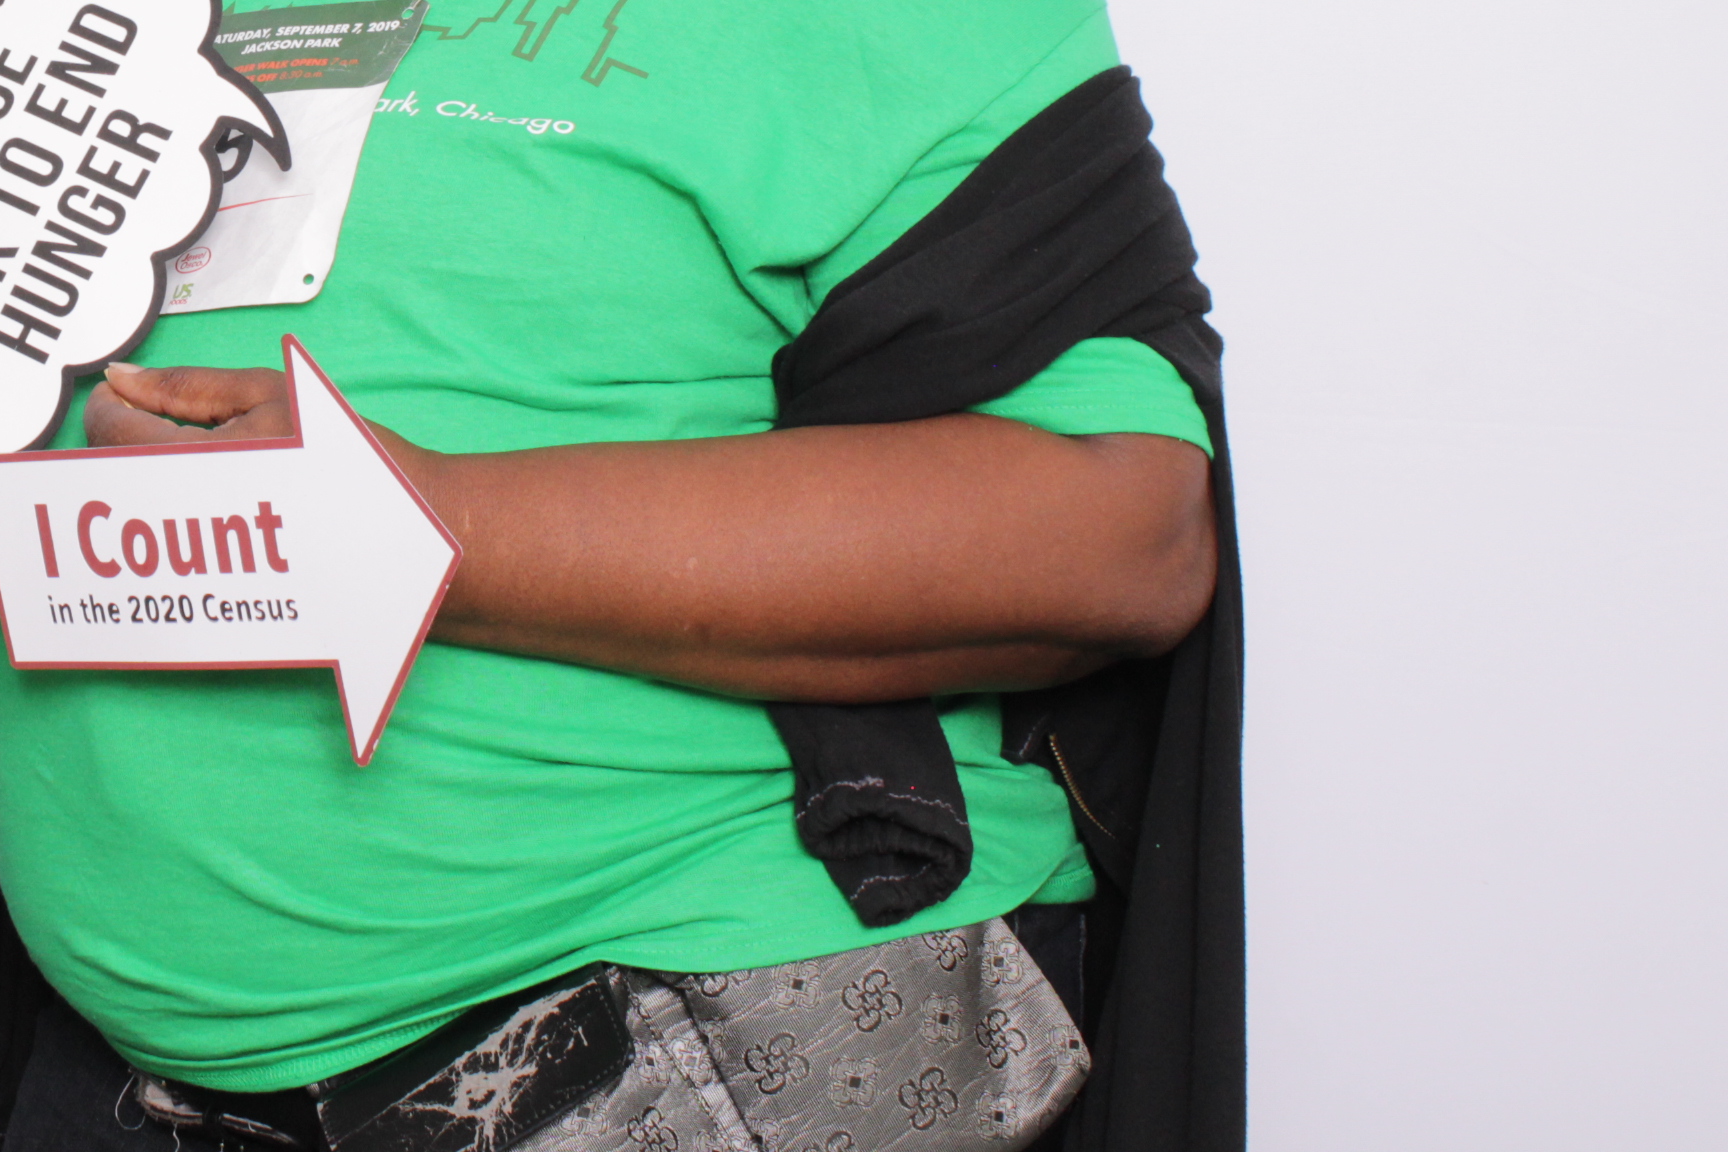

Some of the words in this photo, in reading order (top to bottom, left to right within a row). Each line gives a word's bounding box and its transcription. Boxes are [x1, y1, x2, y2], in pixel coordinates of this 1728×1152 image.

[214, 28, 272, 45] ATURDAY,
[275, 22, 351, 37] SEPTEMBER
[351, 22, 363, 35] 7,
[366, 20, 401, 33] 2019
[241, 39, 303, 55] JACKSON
[304, 37, 343, 49] PARK
[25, 4, 137, 135] END
[435, 100, 575, 135] Chicago
[35, 503, 60, 578] I
[78, 500, 289, 578] Count
[48, 595, 74, 624] in
[80, 594, 121, 624] the
[127, 594, 194, 624] 2020
[201, 593, 299, 623] Census
